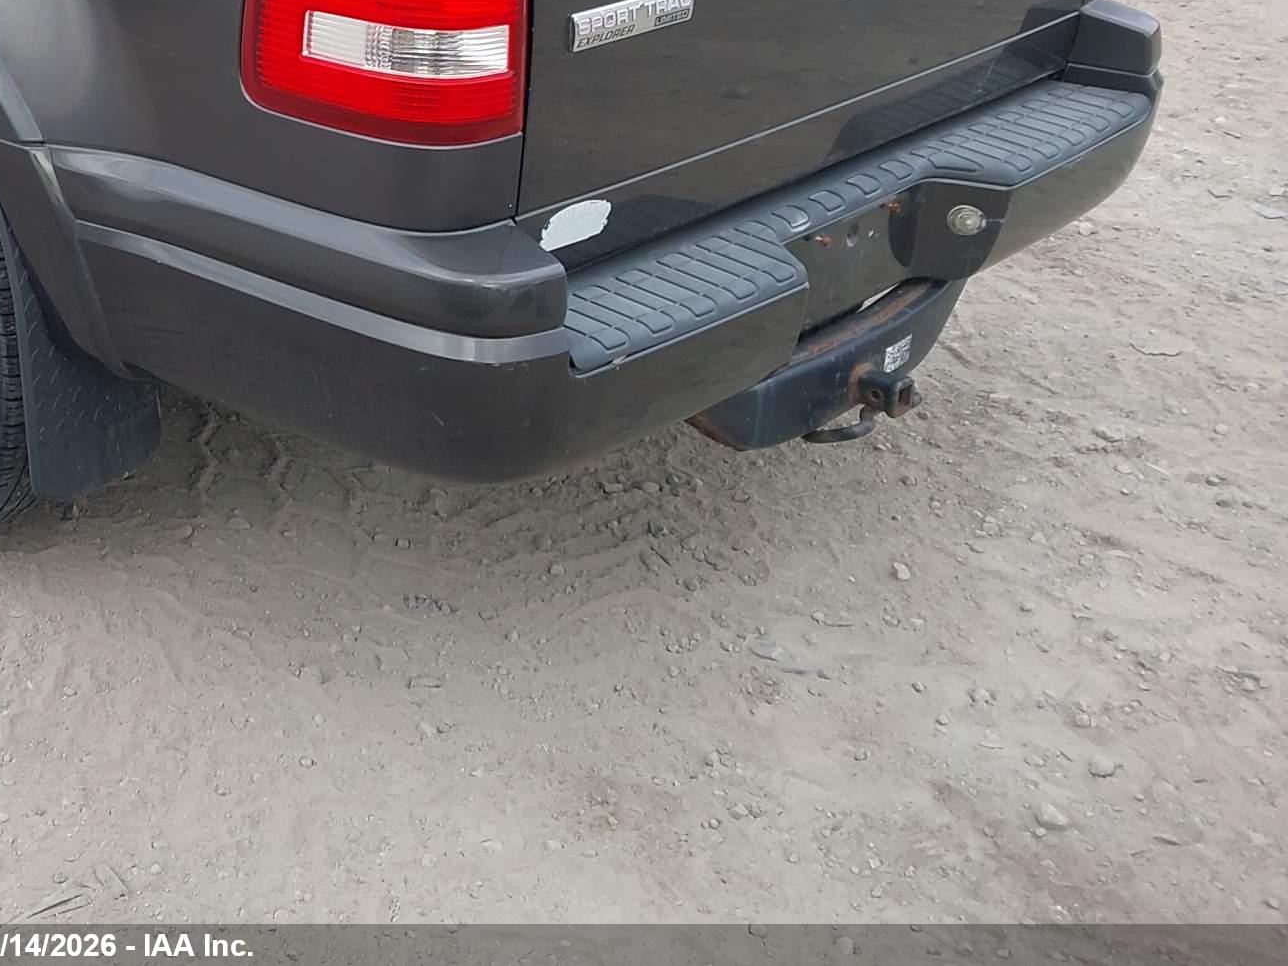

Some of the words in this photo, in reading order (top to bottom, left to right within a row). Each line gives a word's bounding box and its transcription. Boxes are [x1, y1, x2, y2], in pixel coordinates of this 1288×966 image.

[576, 1, 642, 36] SPORT
[655, 8, 690, 26] LIMITED
[576, 24, 636, 49] EXPLORER
